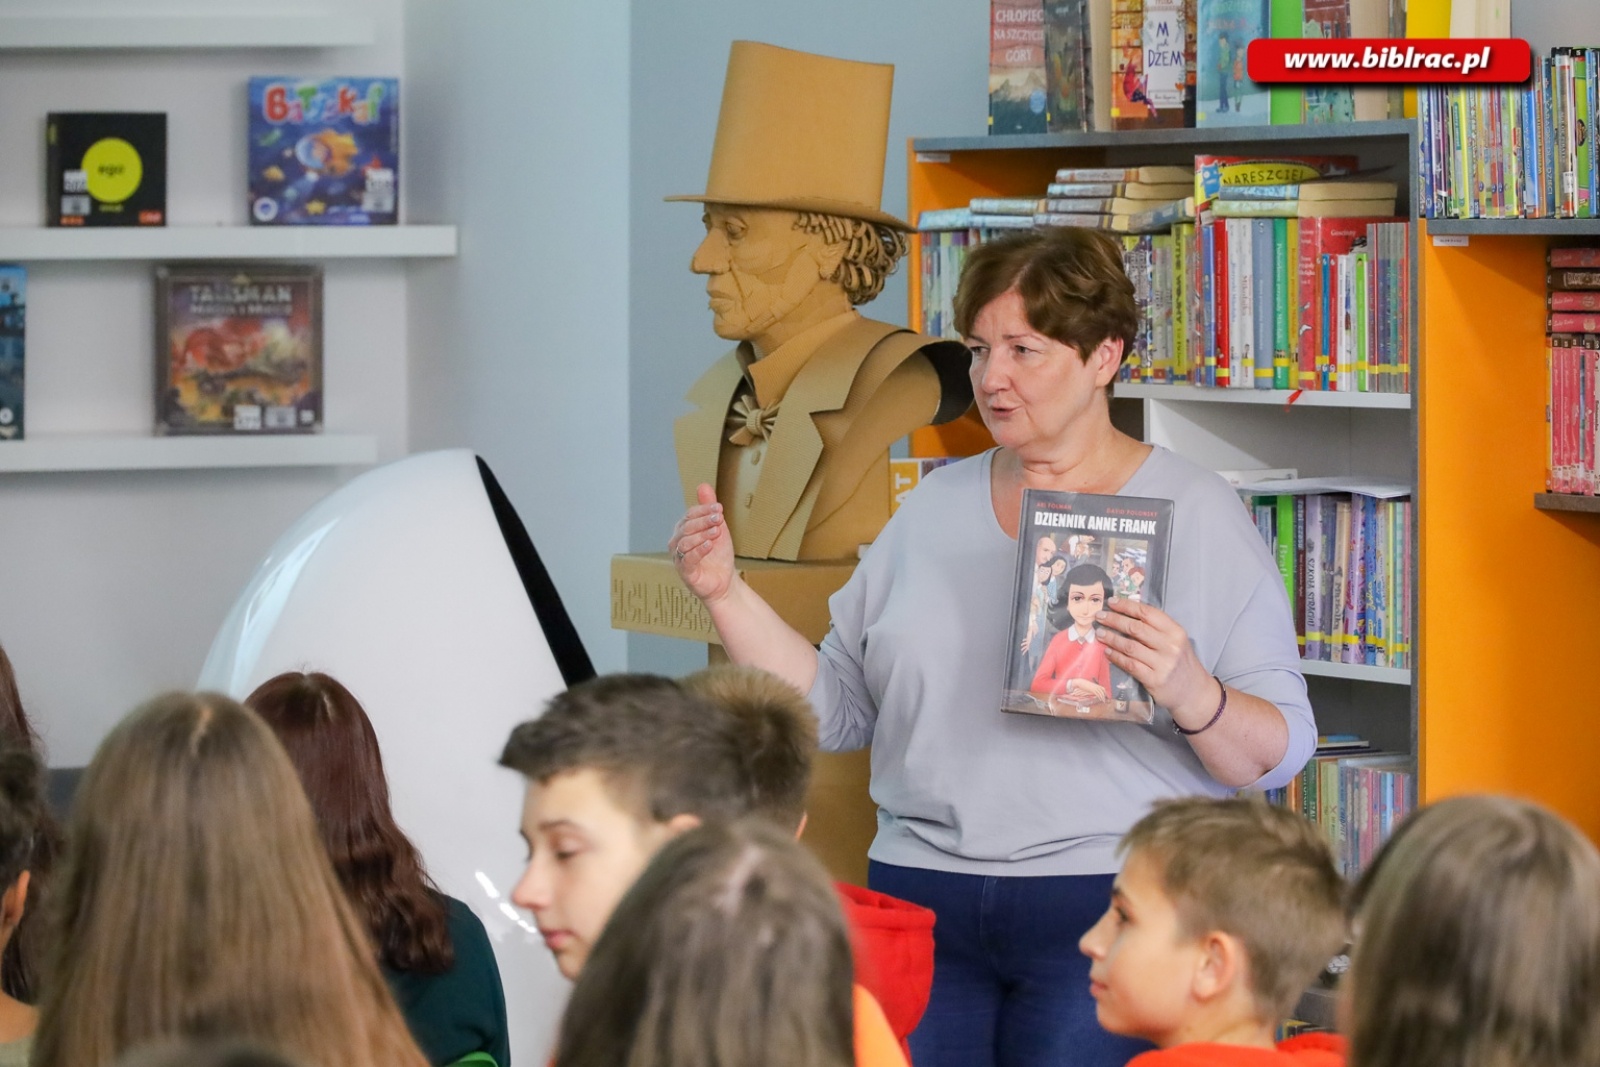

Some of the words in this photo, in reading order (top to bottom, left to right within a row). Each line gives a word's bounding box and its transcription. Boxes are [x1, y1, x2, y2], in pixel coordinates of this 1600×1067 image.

[1156, 22, 1169, 38] M
[1034, 511, 1086, 529] DZIENNIK
[1087, 515, 1117, 532] ANNE
[1119, 517, 1157, 536] FRANK
